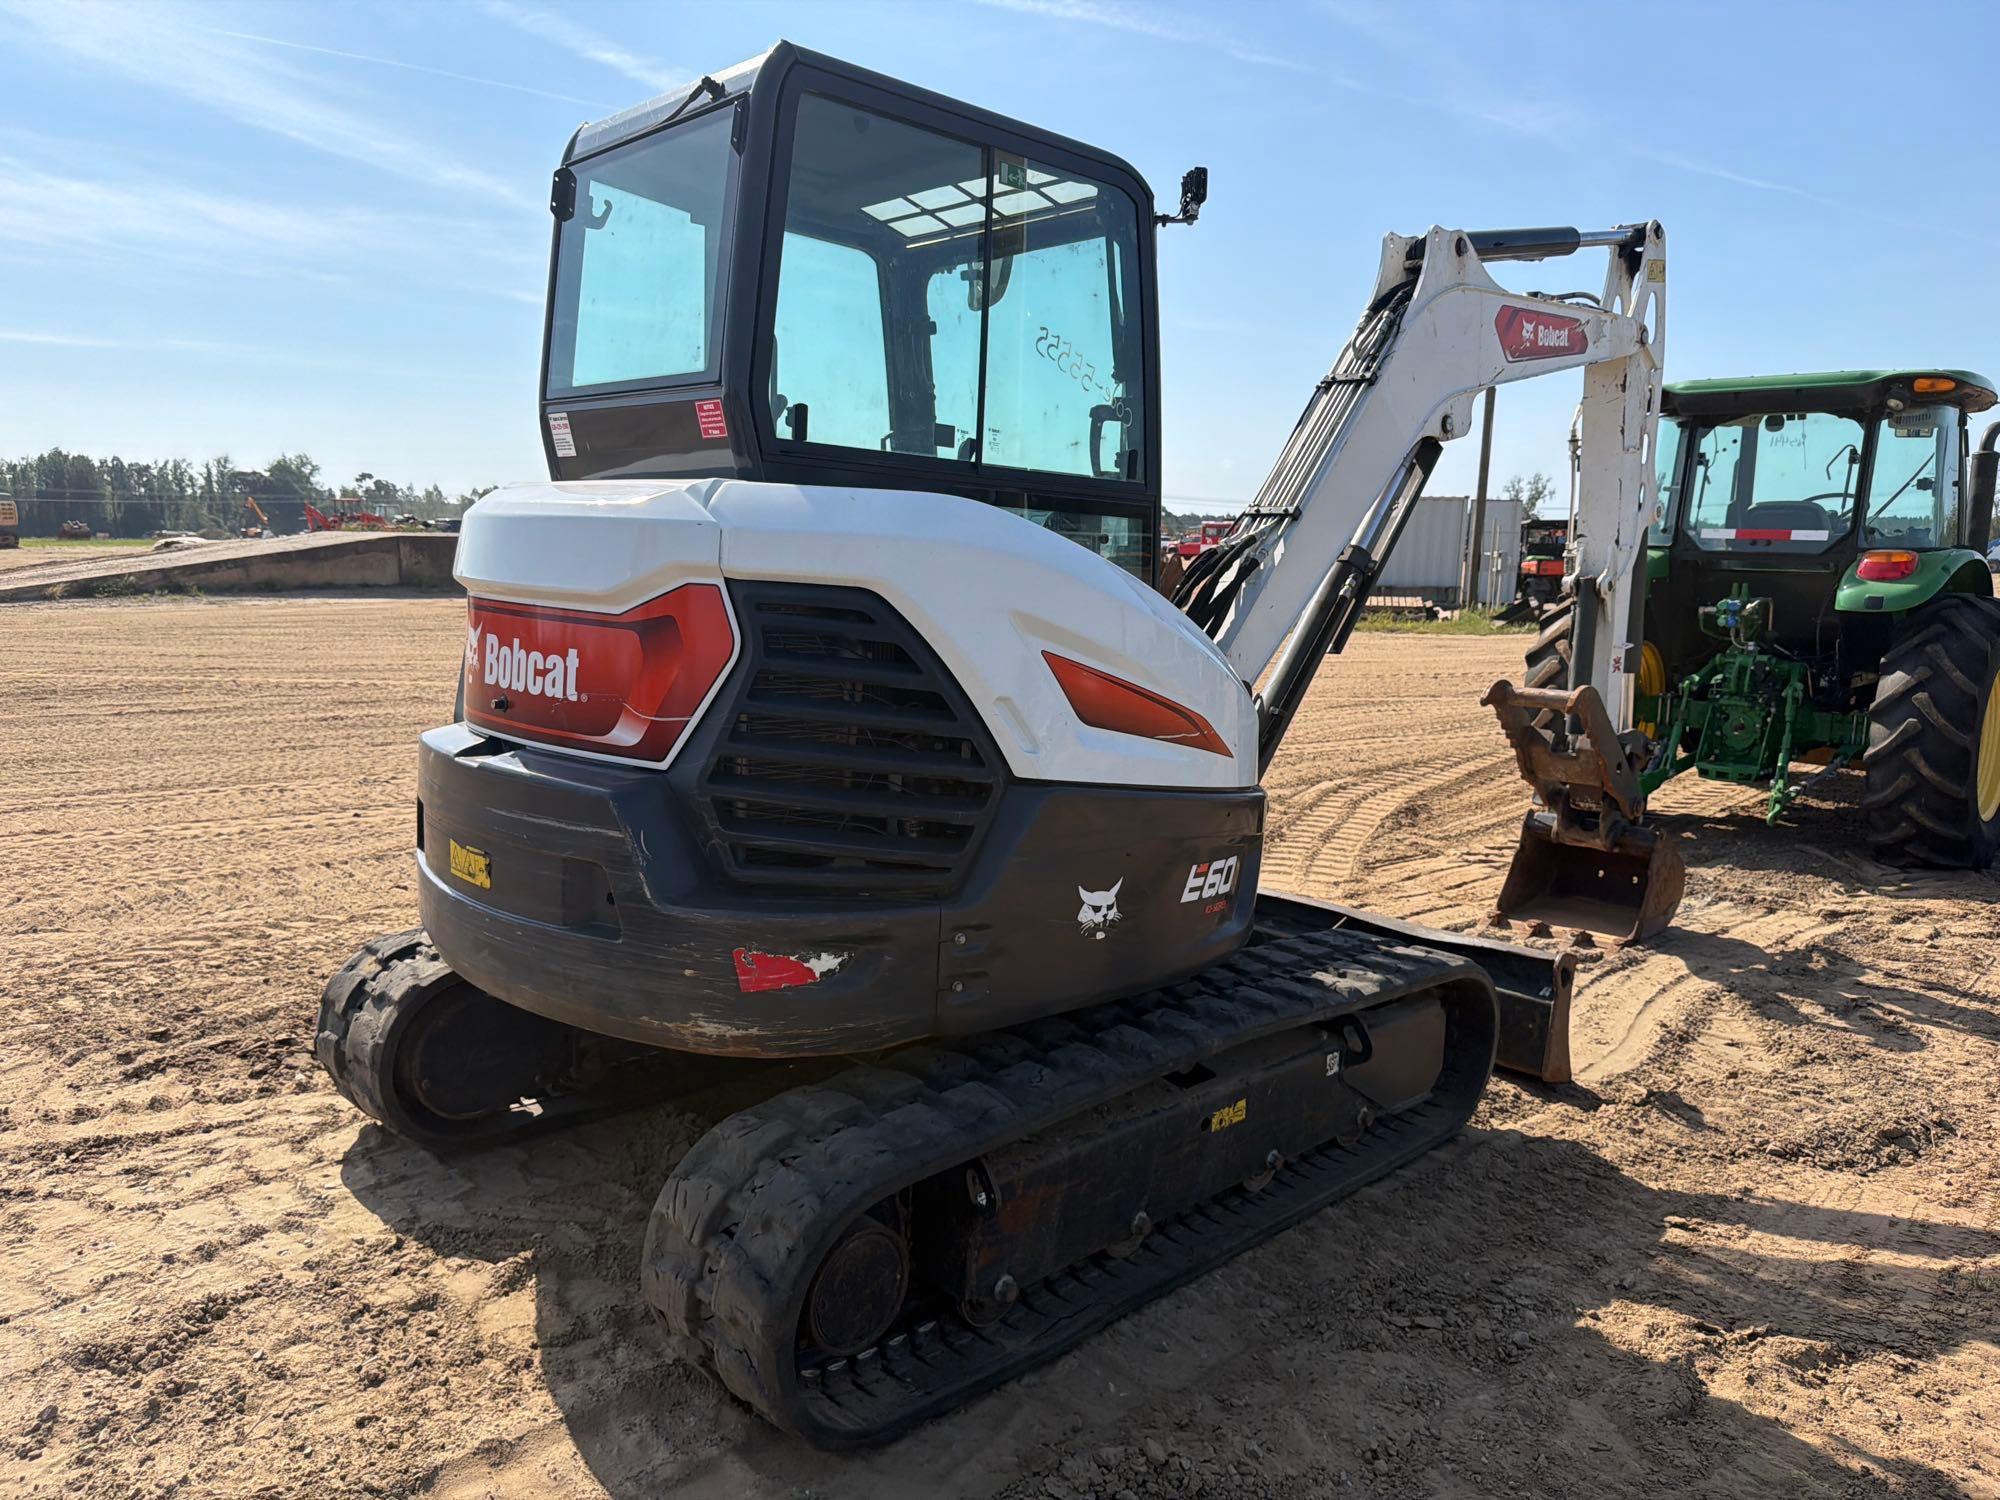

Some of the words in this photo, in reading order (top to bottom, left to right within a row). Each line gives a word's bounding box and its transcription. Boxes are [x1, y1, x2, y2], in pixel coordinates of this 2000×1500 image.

[1537, 325, 1569, 347] Bobcat
[484, 633, 579, 701] Bobcat
[1180, 855, 1238, 903] E60
